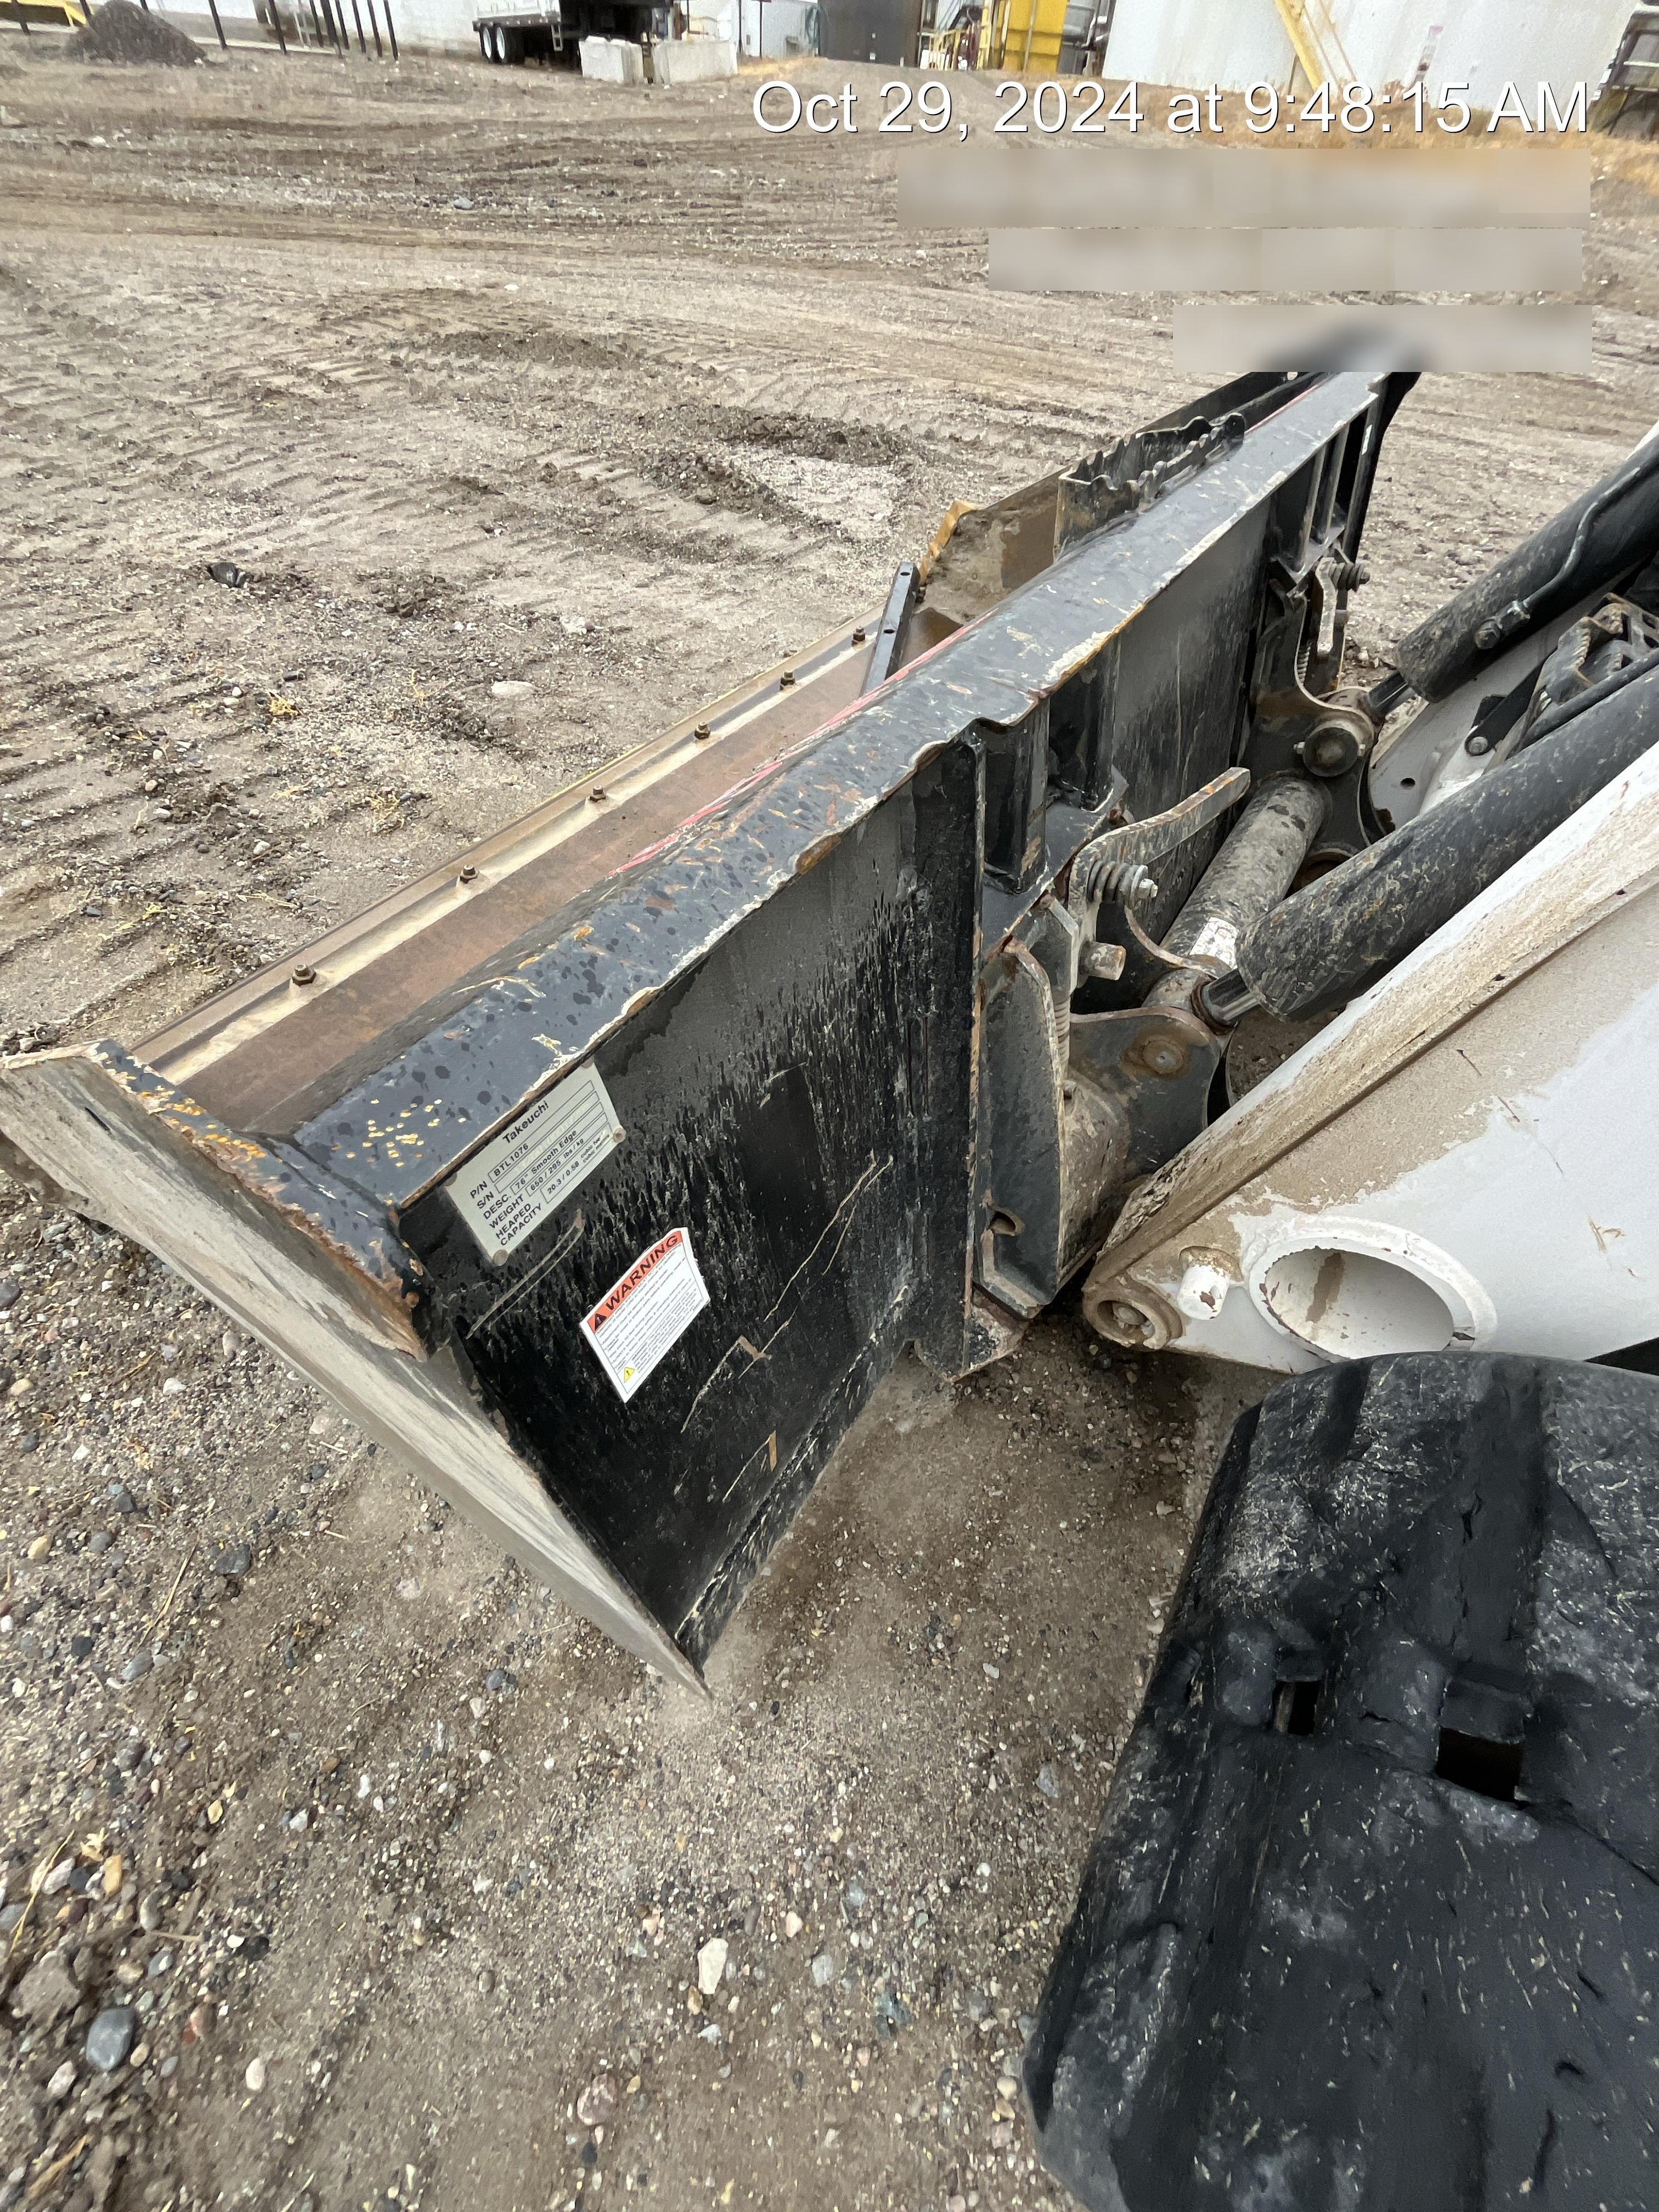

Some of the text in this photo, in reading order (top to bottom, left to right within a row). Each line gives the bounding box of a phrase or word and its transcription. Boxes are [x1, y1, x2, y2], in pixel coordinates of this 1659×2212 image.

[503, 1101, 548, 1143] Takeuchi
[470, 1143, 528, 1198] P/N BTL1076
[532, 1148, 558, 1174] Smooth
[559, 1131, 576, 1150] Edge
[489, 1194, 523, 1228] WEIGHT
[531, 1177, 543, 1190] 650
[549, 1159, 561, 1173] 295
[548, 1179, 561, 1194] 20.3
[566, 1161, 579, 1176] 0.58
[477, 1192, 494, 1209] S/N
[496, 1204, 531, 1239] HEAPED
[501, 1203, 541, 1245] CAPACITY
[606, 1235, 678, 1311] WARNING
